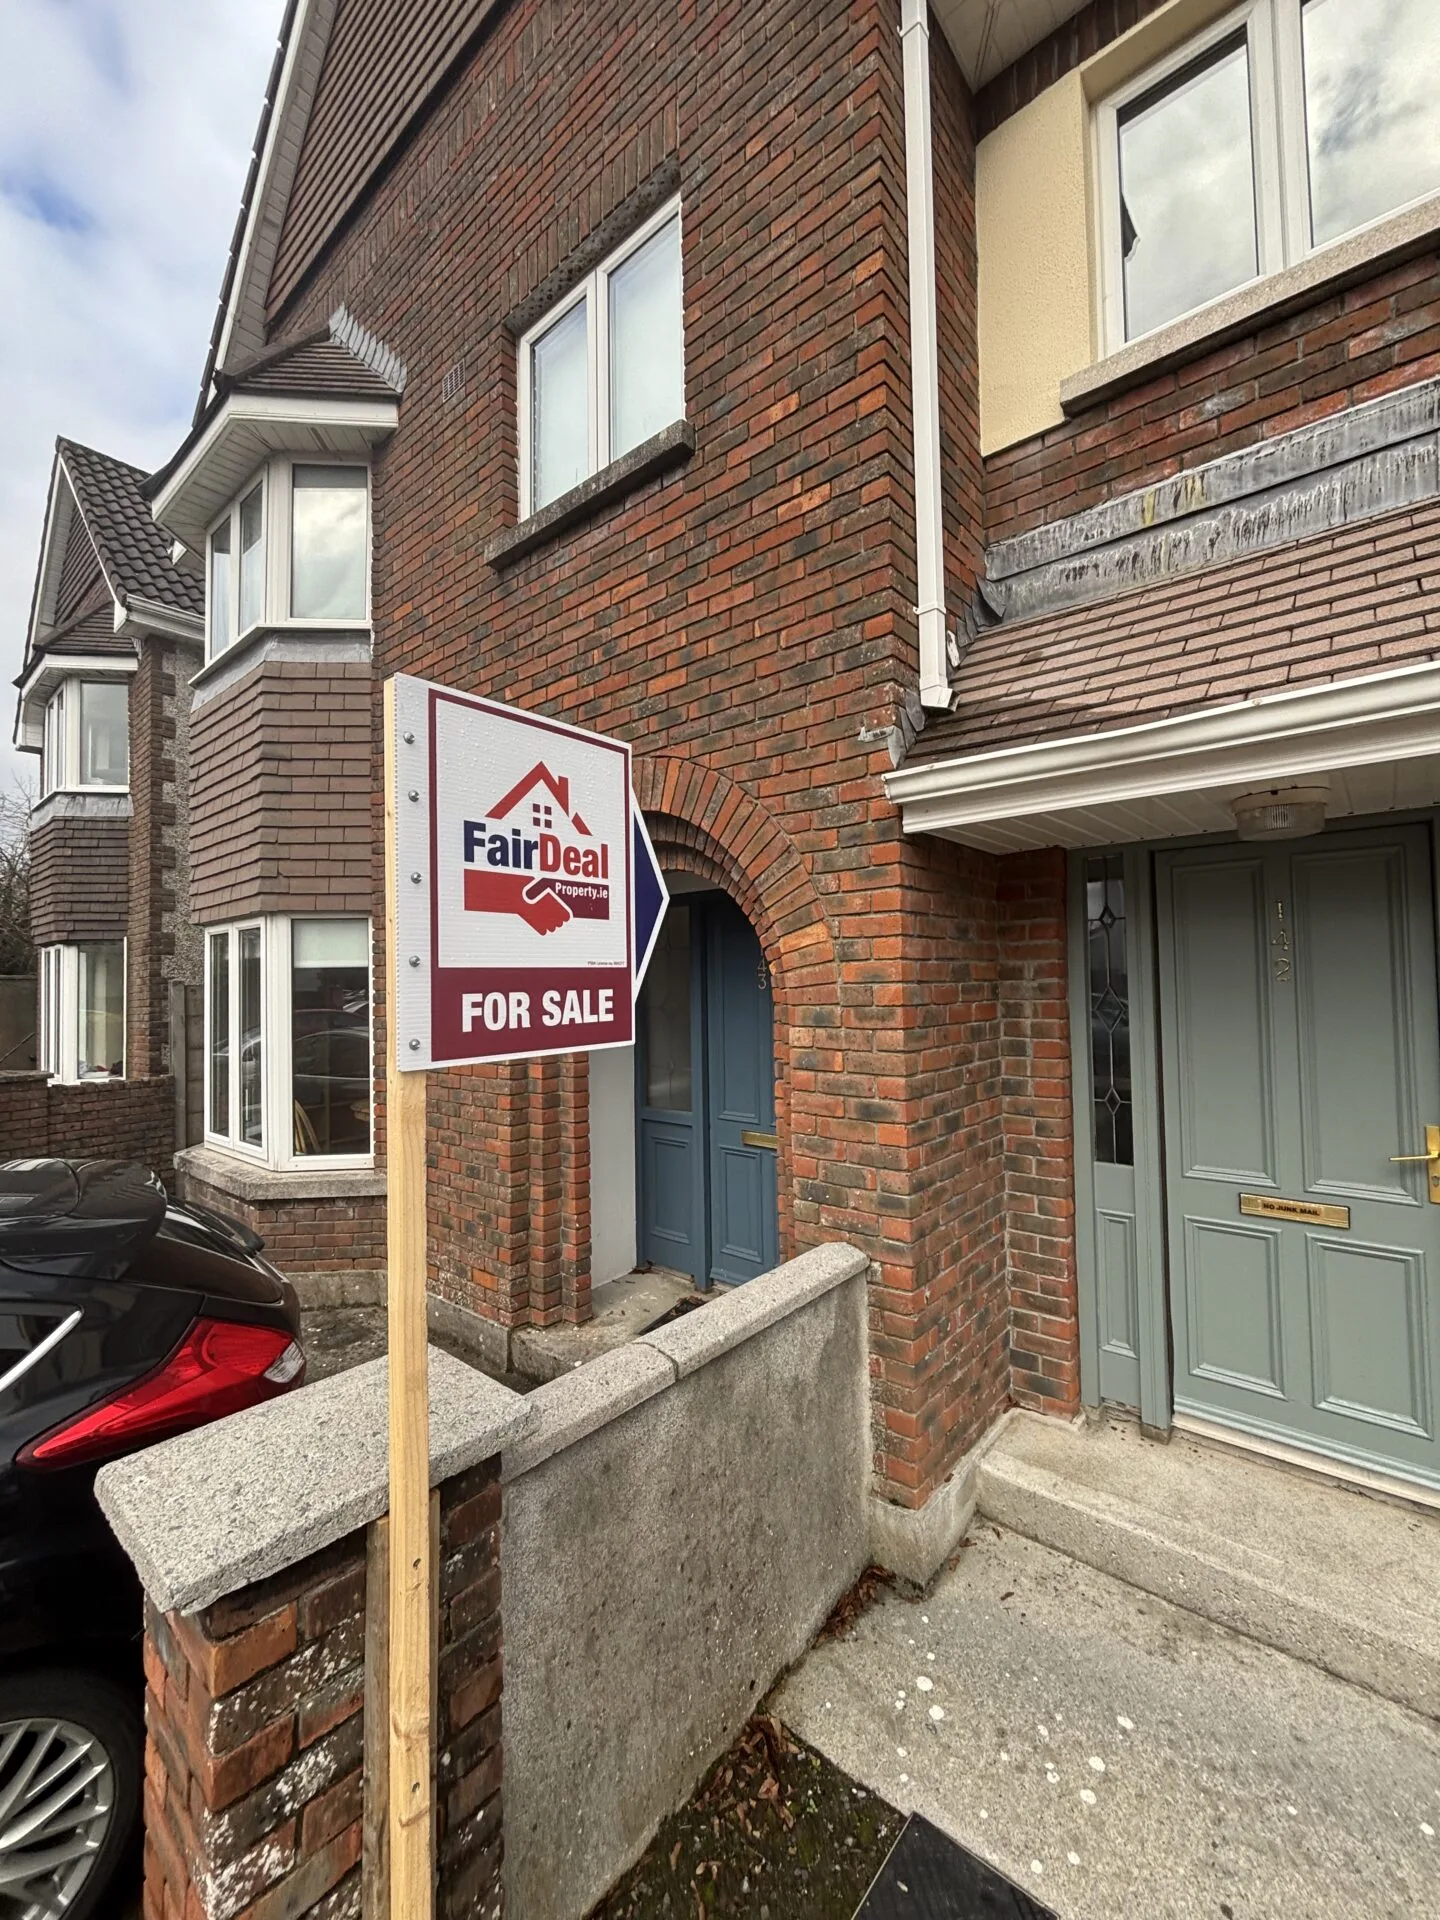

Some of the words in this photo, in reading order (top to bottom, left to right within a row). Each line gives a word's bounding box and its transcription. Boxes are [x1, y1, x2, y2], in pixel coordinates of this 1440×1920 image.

[464, 820, 608, 879] FairDeal
[555, 882, 608, 899] Property.ie
[1271, 898, 1290, 981] 142
[462, 991, 531, 1033] FOR
[542, 988, 614, 1027] SALE
[1276, 1205, 1298, 1213] JUNK
[1299, 1208, 1320, 1216] MAIL
